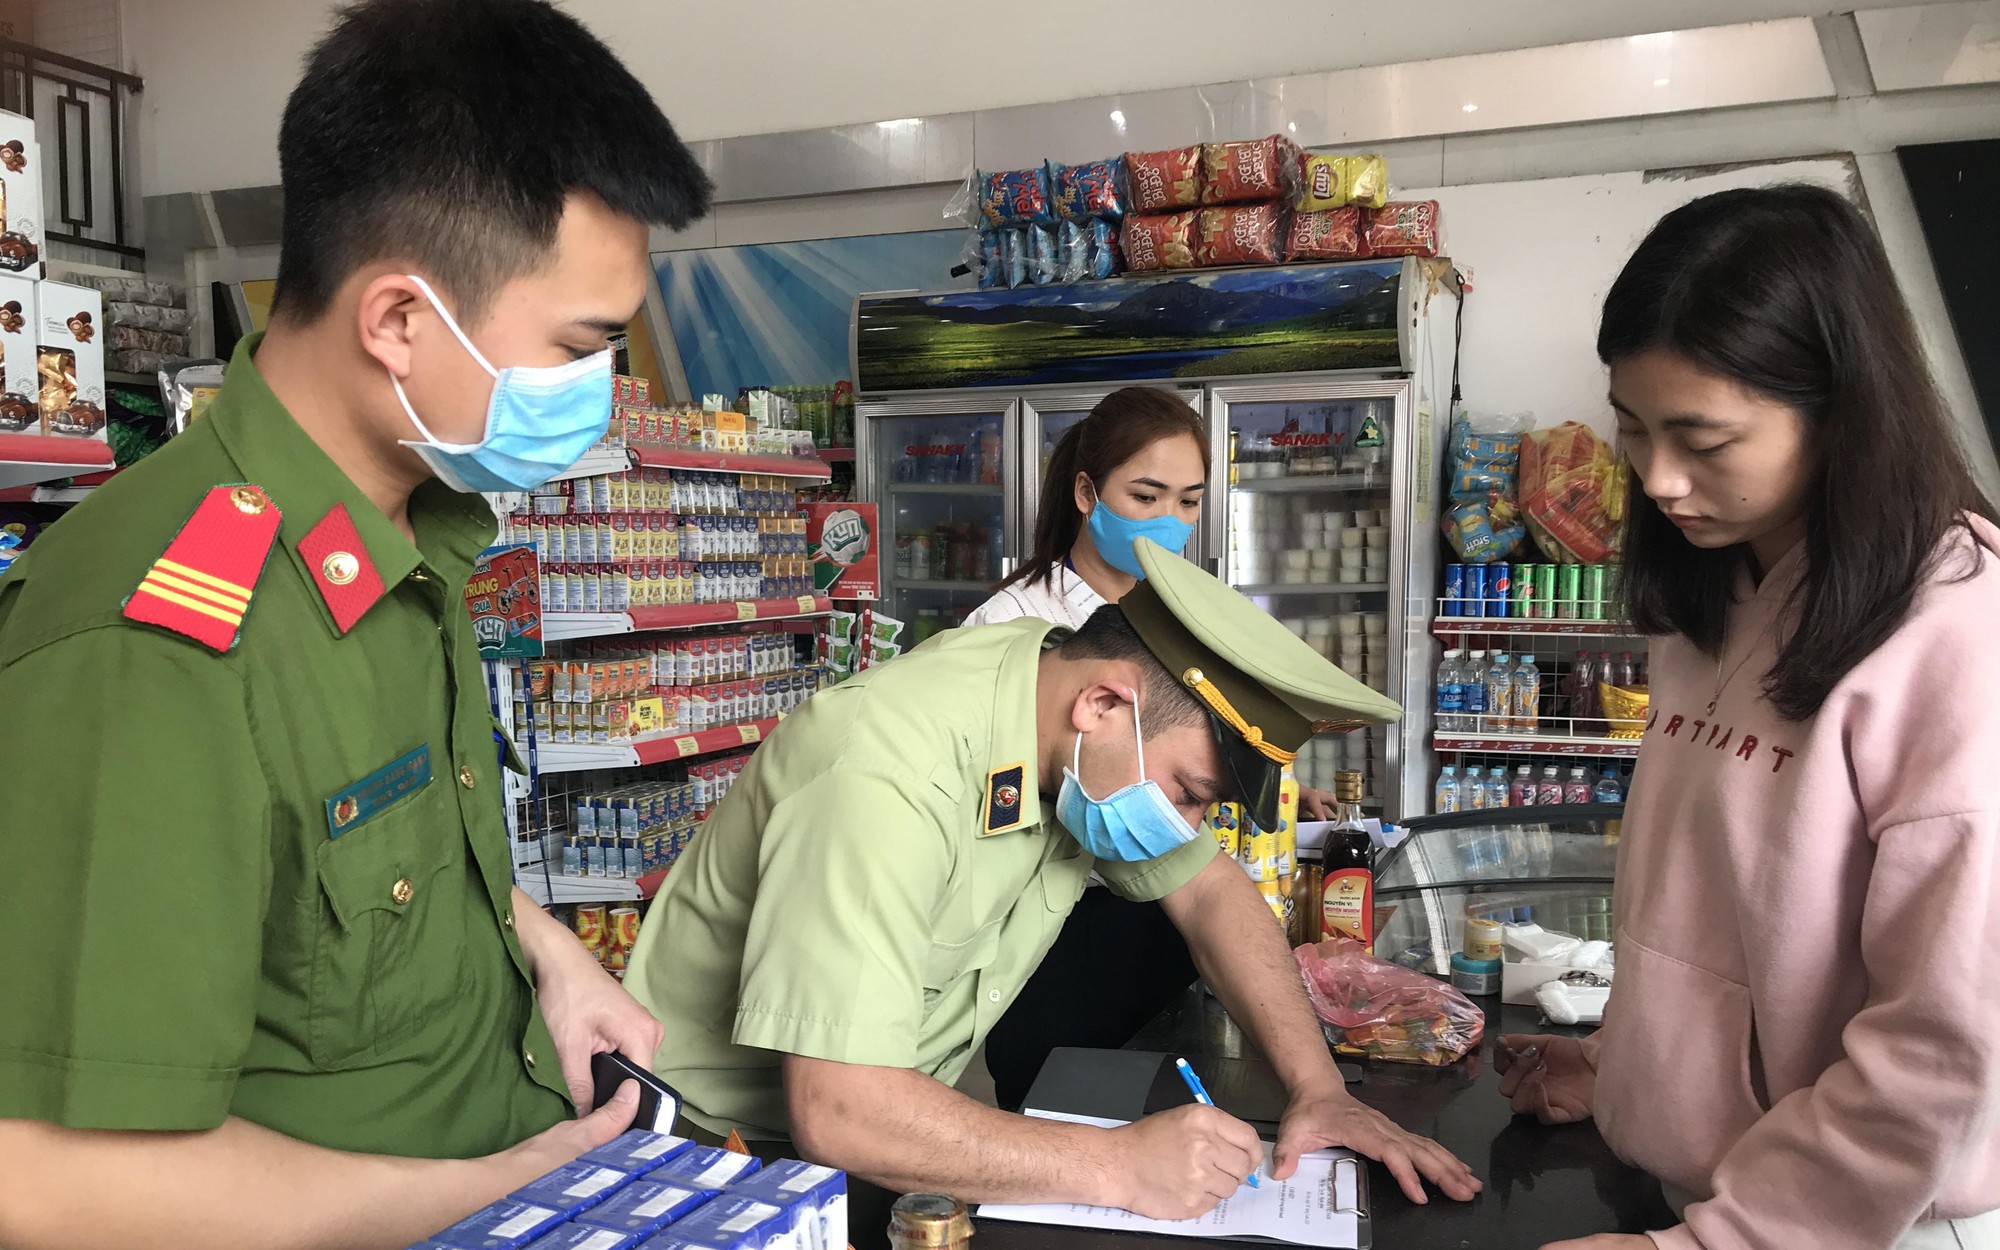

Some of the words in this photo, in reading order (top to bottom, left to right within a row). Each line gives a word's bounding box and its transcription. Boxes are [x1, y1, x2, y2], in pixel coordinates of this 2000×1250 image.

[1135, 161, 1155, 209] Snack
[1248, 206, 1263, 255] Snack
[1129, 222, 1146, 270] Snack
[1270, 433, 1346, 446] SANAKY
[905, 444, 966, 456] SANAKY
[464, 578, 499, 598] TRÚNG
[473, 597, 492, 613] QUÀ
